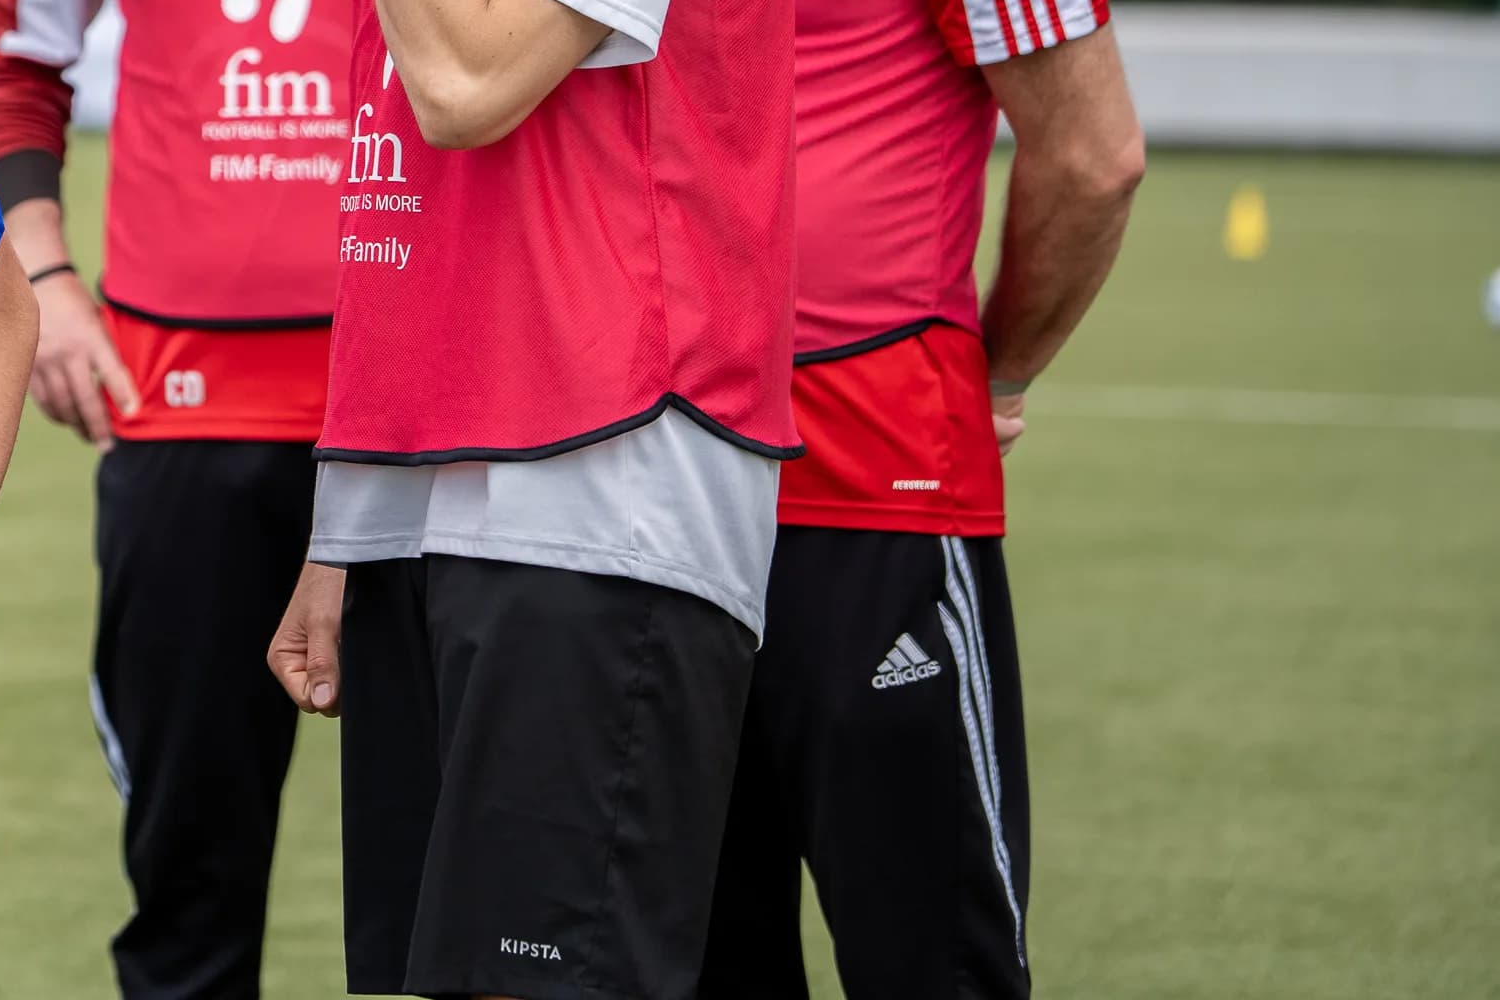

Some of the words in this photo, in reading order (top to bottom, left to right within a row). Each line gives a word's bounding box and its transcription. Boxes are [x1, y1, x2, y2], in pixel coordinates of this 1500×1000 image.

[218, 47, 334, 117] fim
[202, 121, 277, 140] FOOTBALL
[279, 120, 298, 138] IS
[300, 119, 349, 138] MORE
[210, 154, 344, 184] FIM-Family
[361, 193, 372, 210] IS
[375, 194, 422, 213] MORE
[164, 370, 206, 408] CD
[871, 660, 942, 690] adidas
[500, 937, 562, 961] KIPSTA
